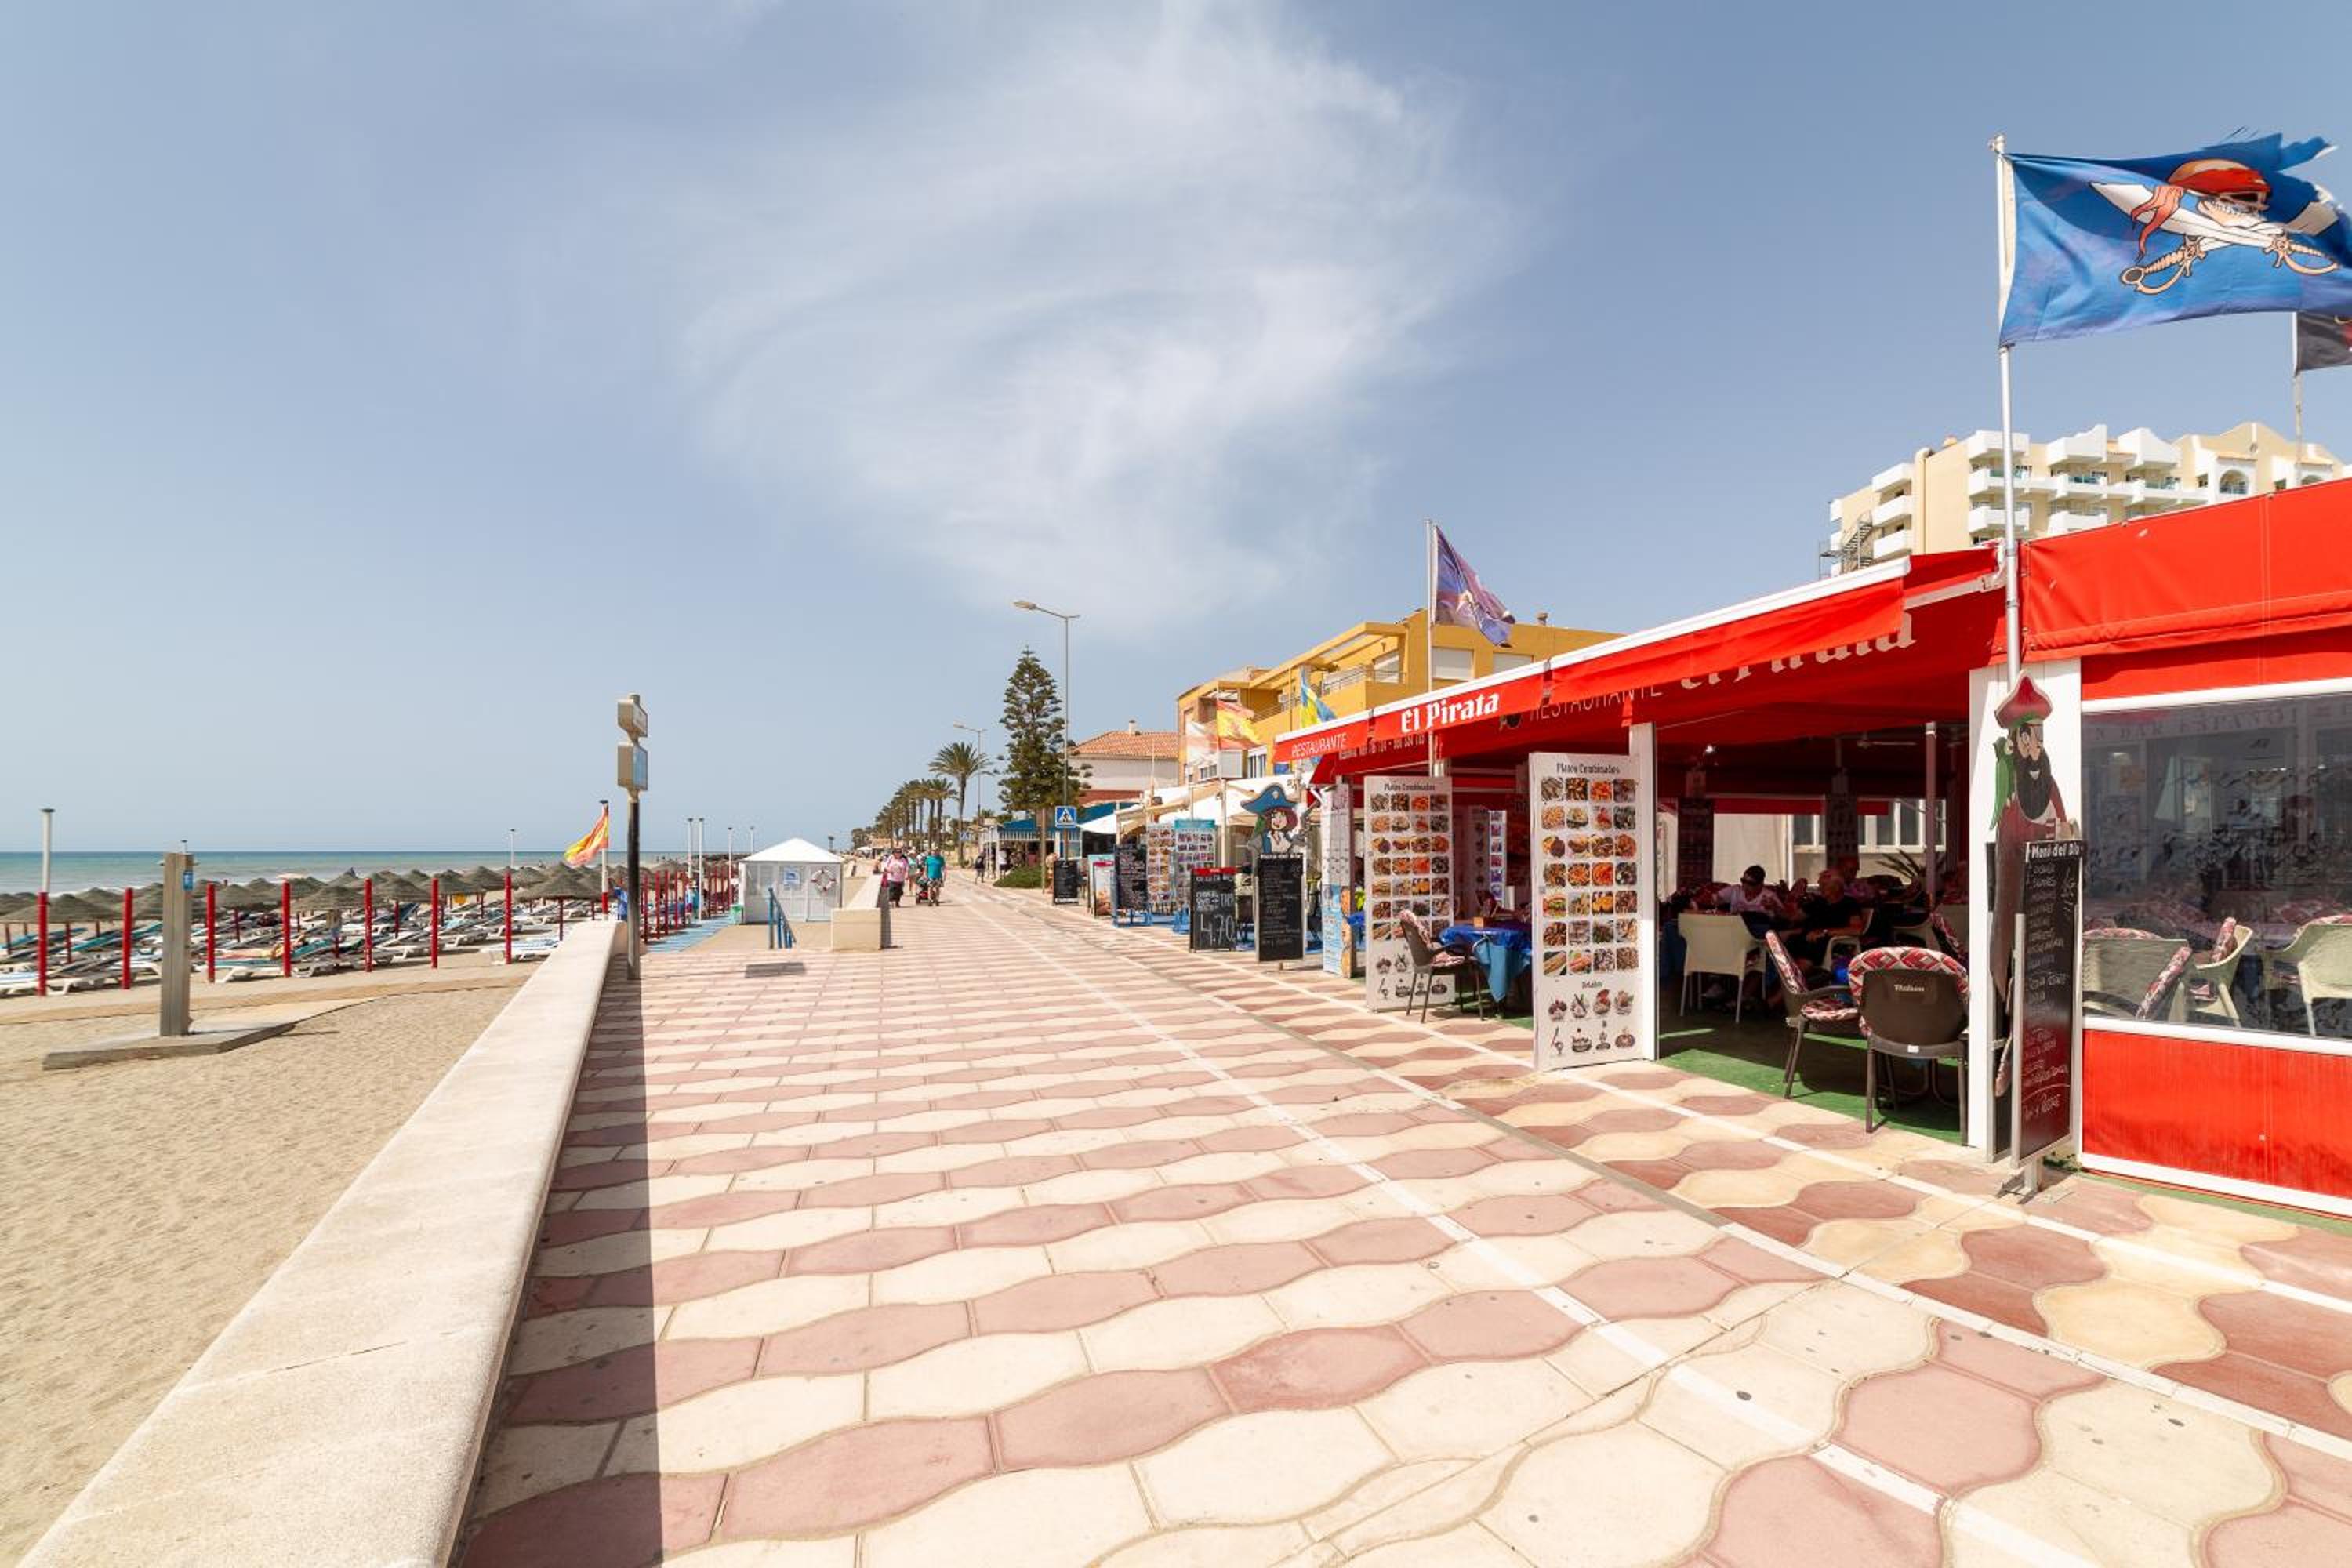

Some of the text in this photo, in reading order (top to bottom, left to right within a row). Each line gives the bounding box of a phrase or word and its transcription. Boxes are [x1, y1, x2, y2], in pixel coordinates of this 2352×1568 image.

[1401, 692, 1499, 733] El Pirata
[1291, 732, 1348, 758] RESTAURANTE
[1580, 763, 1620, 775] Combinados
